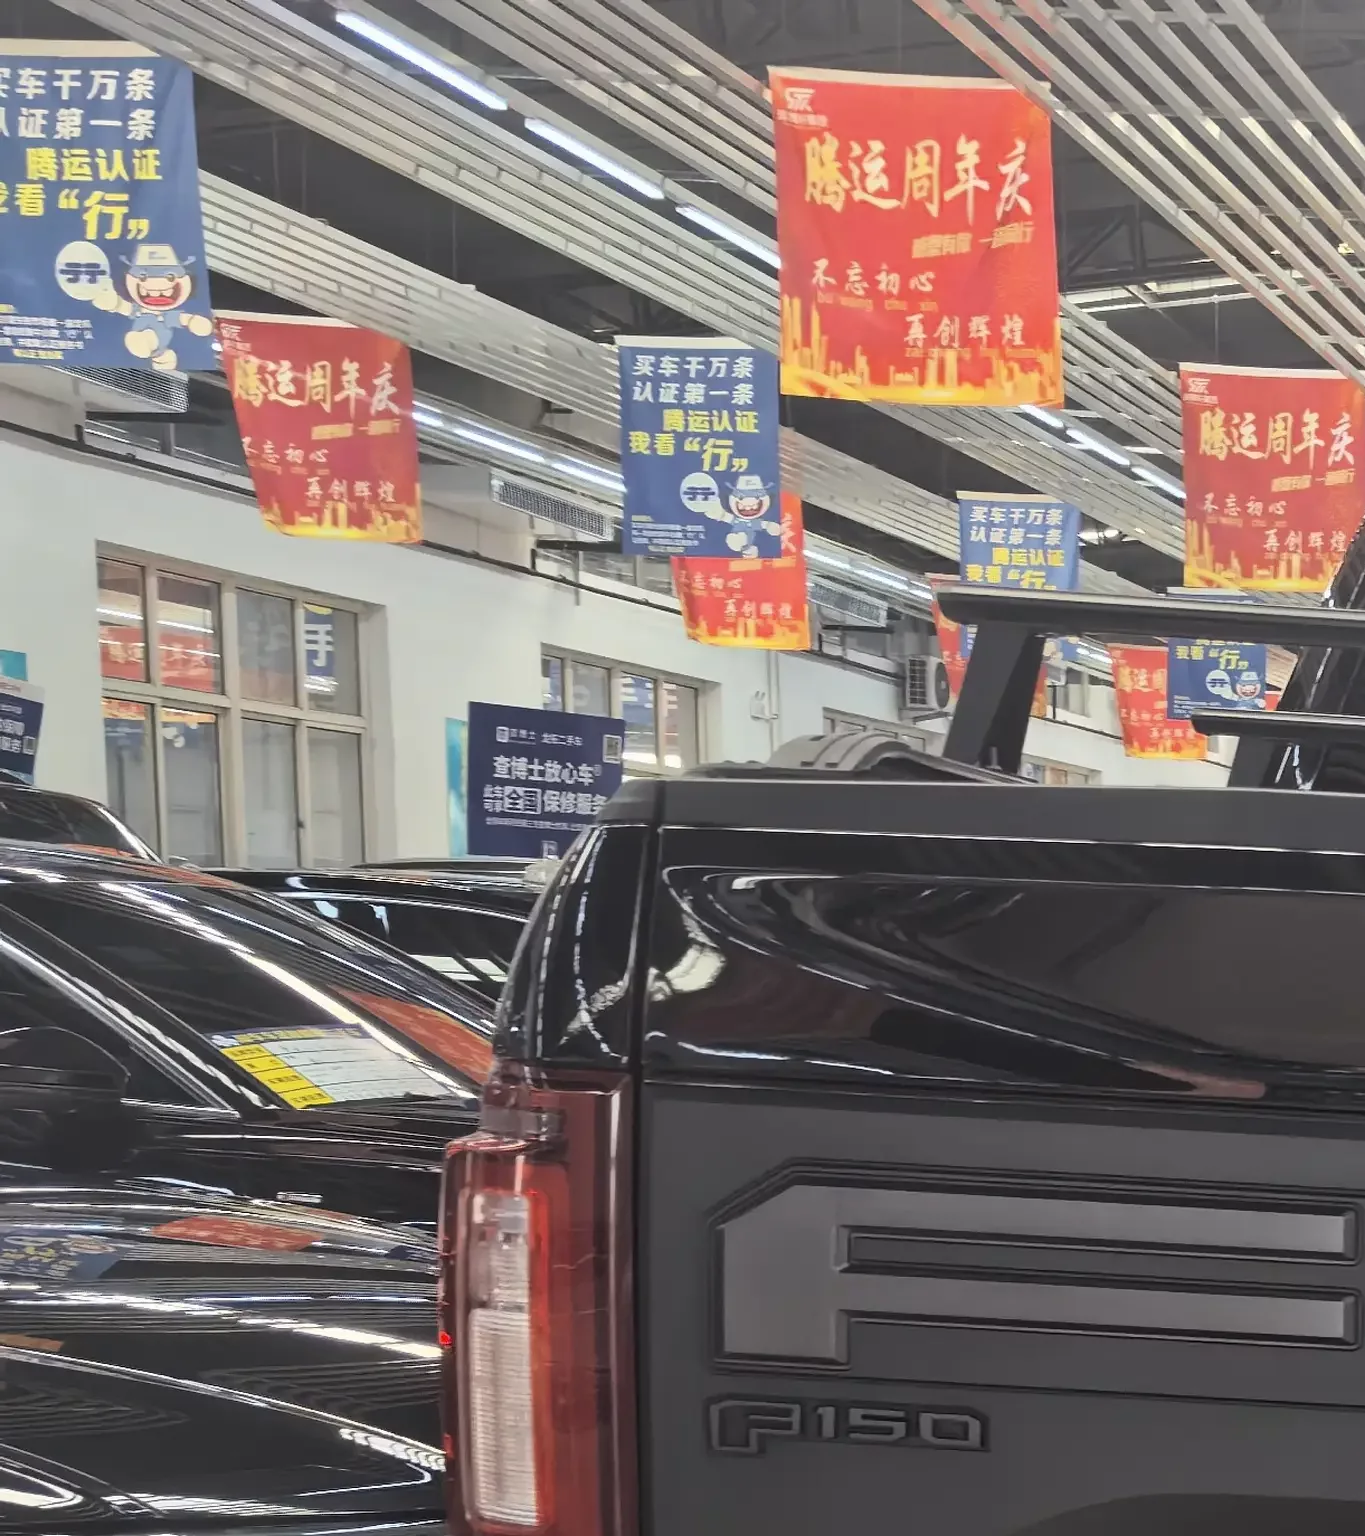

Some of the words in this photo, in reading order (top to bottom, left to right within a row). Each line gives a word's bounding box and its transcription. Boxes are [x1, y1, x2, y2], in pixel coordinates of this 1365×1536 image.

[0, 107, 156, 141] 证第一条
[26, 147, 163, 181] 腾运认证
[804, 132, 1034, 226] 腾运周年庆
[0, 183, 150, 240] 看“行”
[812, 258, 936, 296] 不忘初心
[903, 313, 1026, 350] 再创辉煌
[632, 354, 755, 379] 买车千万条
[234, 355, 401, 419] 腾运周年庆
[632, 381, 755, 405] 认证第一条
[663, 409, 760, 433] 腾运认证
[1199, 407, 1355, 469] 腾运周年庆
[305, 477, 397, 502] 再创辉煌
[970, 506, 1063, 526] 买车千万条
[1202, 493, 1287, 517] 不忘初心
[970, 526, 1062, 545] 认证第一条
[1264, 529, 1347, 553] 再创辉煌
